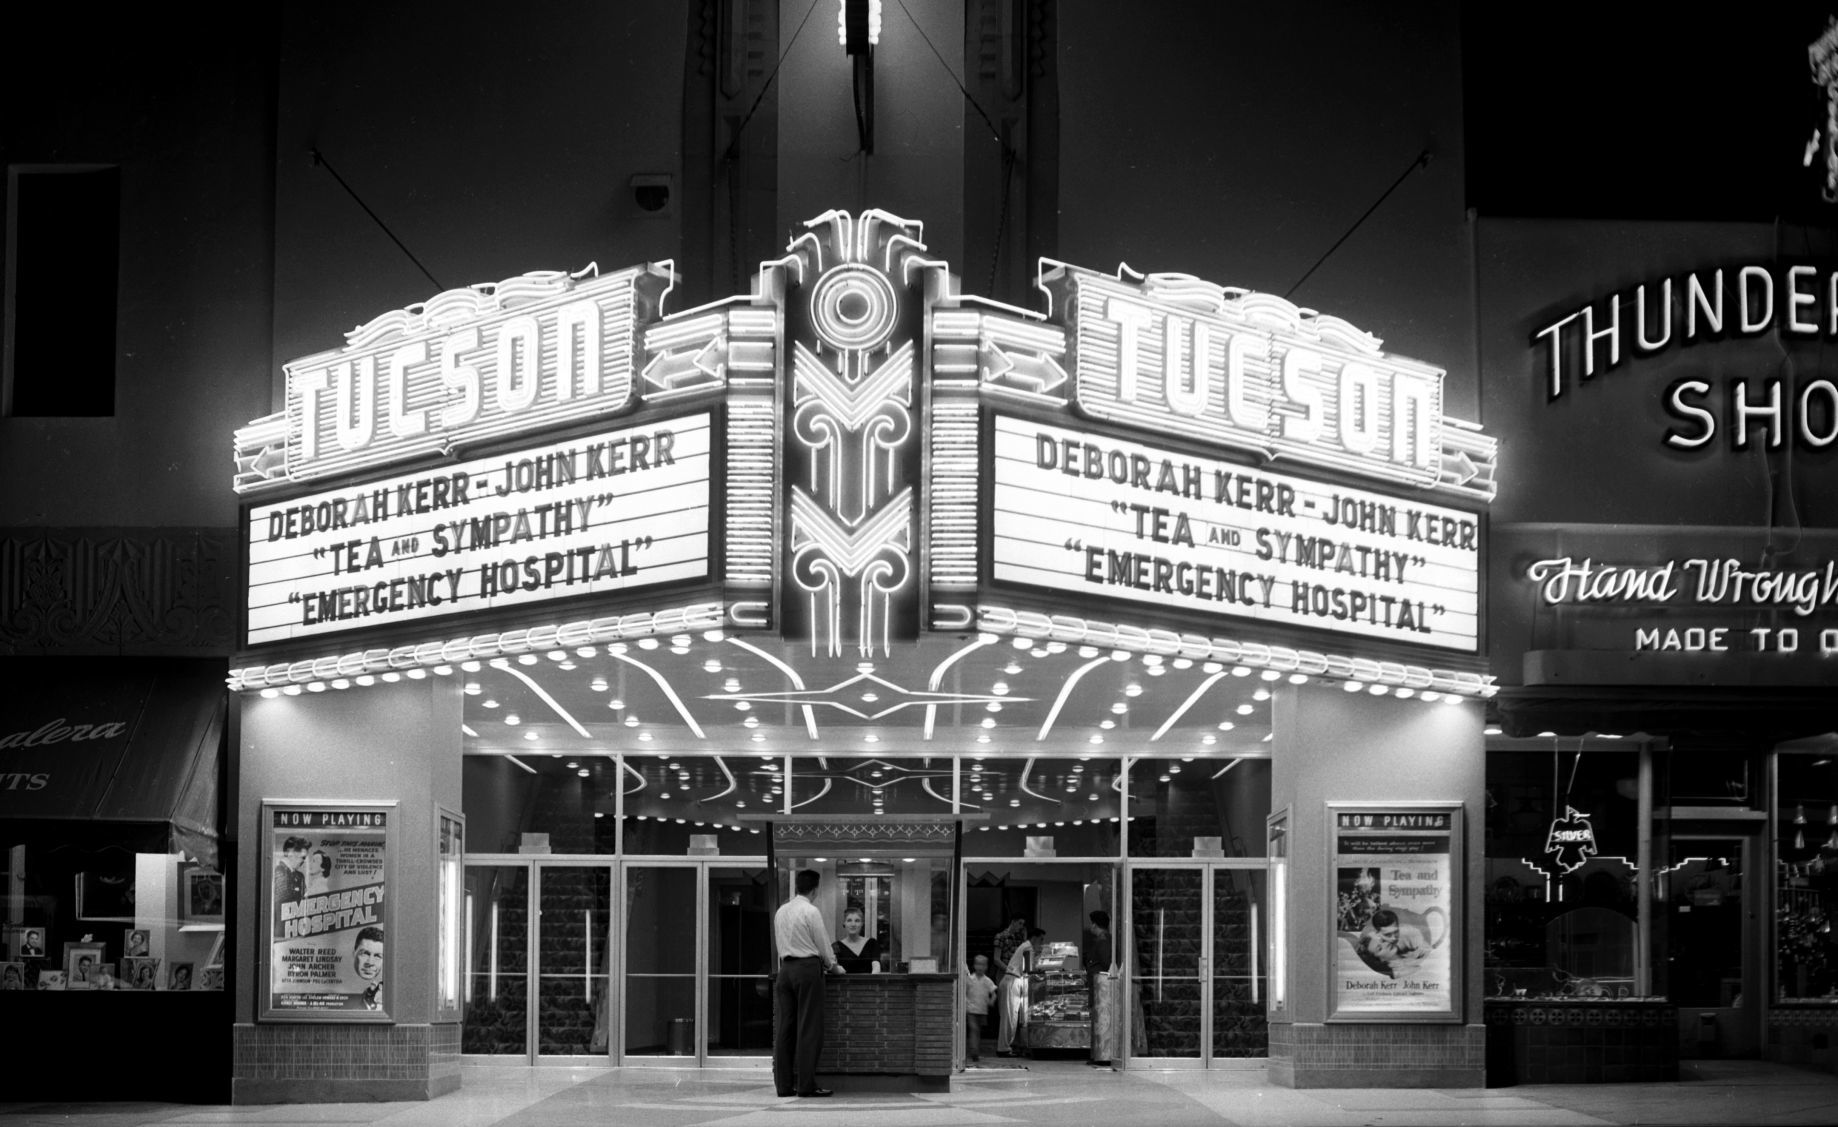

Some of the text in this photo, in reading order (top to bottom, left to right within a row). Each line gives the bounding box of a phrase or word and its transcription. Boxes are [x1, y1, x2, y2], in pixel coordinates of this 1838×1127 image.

[294, 301, 604, 460] TUCSON
[1105, 296, 1434, 467] TUCSON
[268, 488, 388, 542] DEBORAH
[397, 472, 470, 517] KERR
[495, 448, 576, 498] JOHN
[586, 429, 676, 481] KERR
[1036, 432, 1202, 500] DEBORAH
[1215, 470, 1296, 518] KERR
[1323, 493, 1396, 538] JOHN
[1407, 508, 1476, 552] KERR
[1209, 527, 1241, 546] AND
[391, 537, 419, 556] AND
[1527, 557, 1677, 605] Hand
[1635, 628, 1728, 651] MADE
[1750, 628, 1798, 652] TO
[0, 773, 51, 791] TS
[281, 813, 381, 825] NOW PLAYING
[1342, 815, 1444, 827] NOW PLAYING
[1554, 829, 1592, 842] SILVER
[1390, 869, 1438, 881] Tea and
[1388, 884, 1441, 899] Sympathy
[281, 884, 384, 921] EMERGENCY
[284, 905, 377, 939] HOSPITAL
[310, 970, 337, 978] PALMER
[1346, 980, 1440, 990] Deborah Kerr John Kerr
